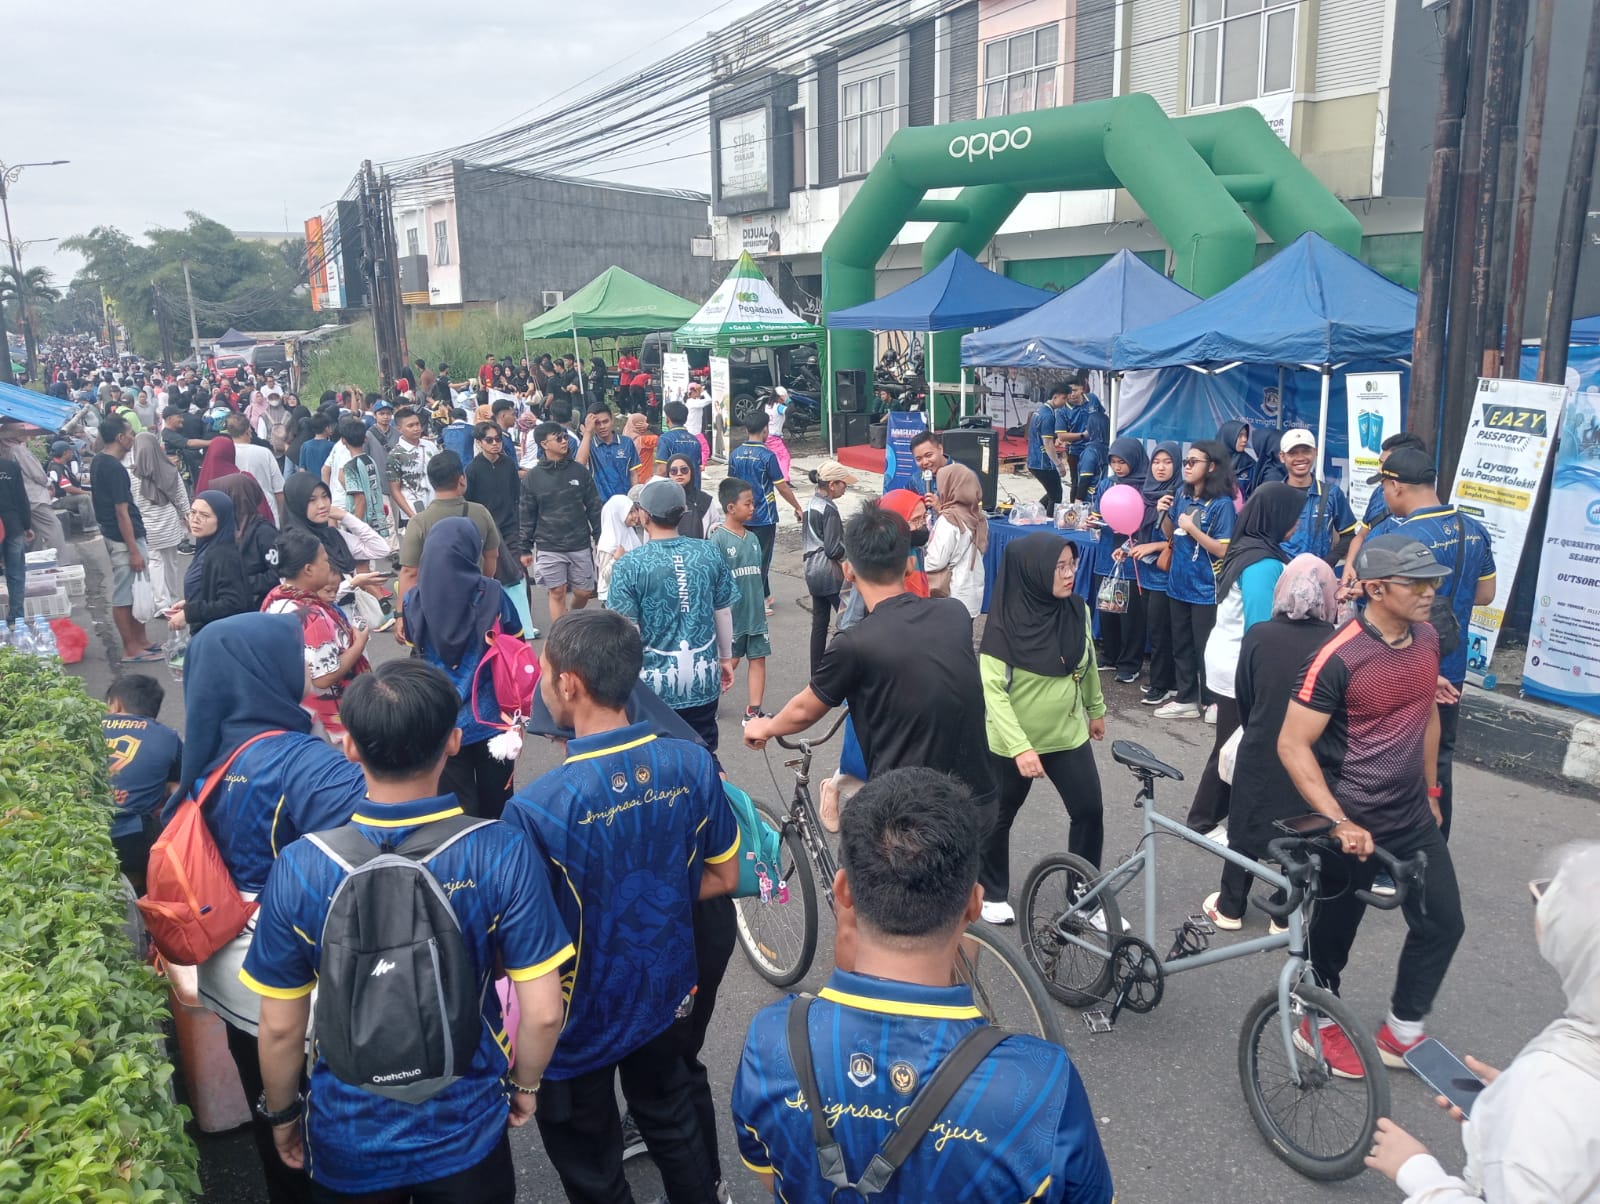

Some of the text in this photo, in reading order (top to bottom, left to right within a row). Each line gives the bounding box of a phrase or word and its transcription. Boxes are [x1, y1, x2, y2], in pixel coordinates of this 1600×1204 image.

[948, 126, 1032, 163] oppo
[743, 227, 769, 239] DIJUAL
[738, 304, 783, 315] Pegadaian
[1488, 411, 1545, 428] EAZY
[1477, 430, 1526, 445] PASSPORT
[672, 555, 690, 613] RUNNING
[578, 785, 690, 826] Imigrasi Cianjur
